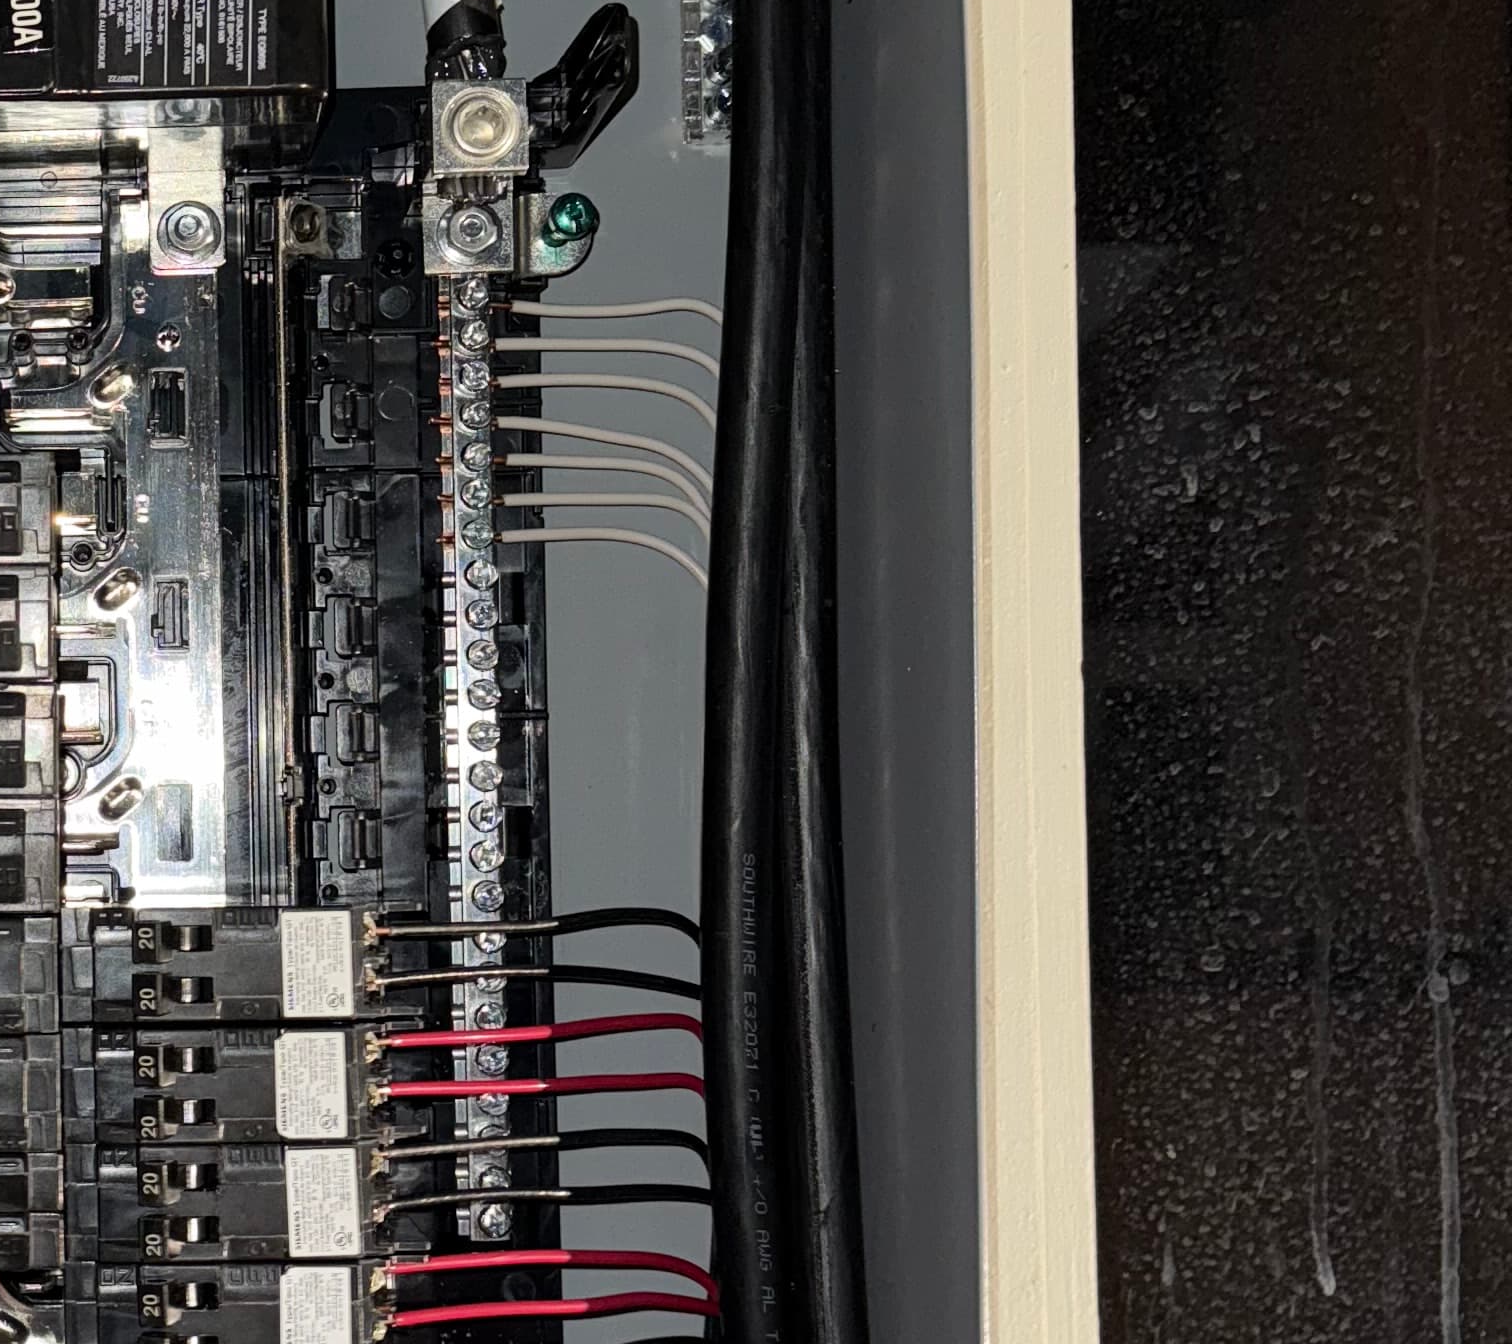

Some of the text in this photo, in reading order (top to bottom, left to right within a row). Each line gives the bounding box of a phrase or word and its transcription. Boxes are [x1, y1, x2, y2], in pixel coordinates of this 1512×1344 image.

[195, 6, 204, 28] Type
[257, 8, 267, 34] TYPE
[742, 852, 758, 977] SOUTHWIRE
[138, 927, 154, 949] 20
[140, 988, 156, 1010] 20
[743, 991, 760, 1071] E32071
[138, 1055, 154, 1078] 20
[140, 1116, 157, 1138] 20
[142, 1172, 159, 1195] 20
[144, 1233, 162, 1256] 20
[756, 1228, 773, 1272] AWG
[143, 1294, 159, 1316] 20
[760, 1286, 777, 1313] AL
